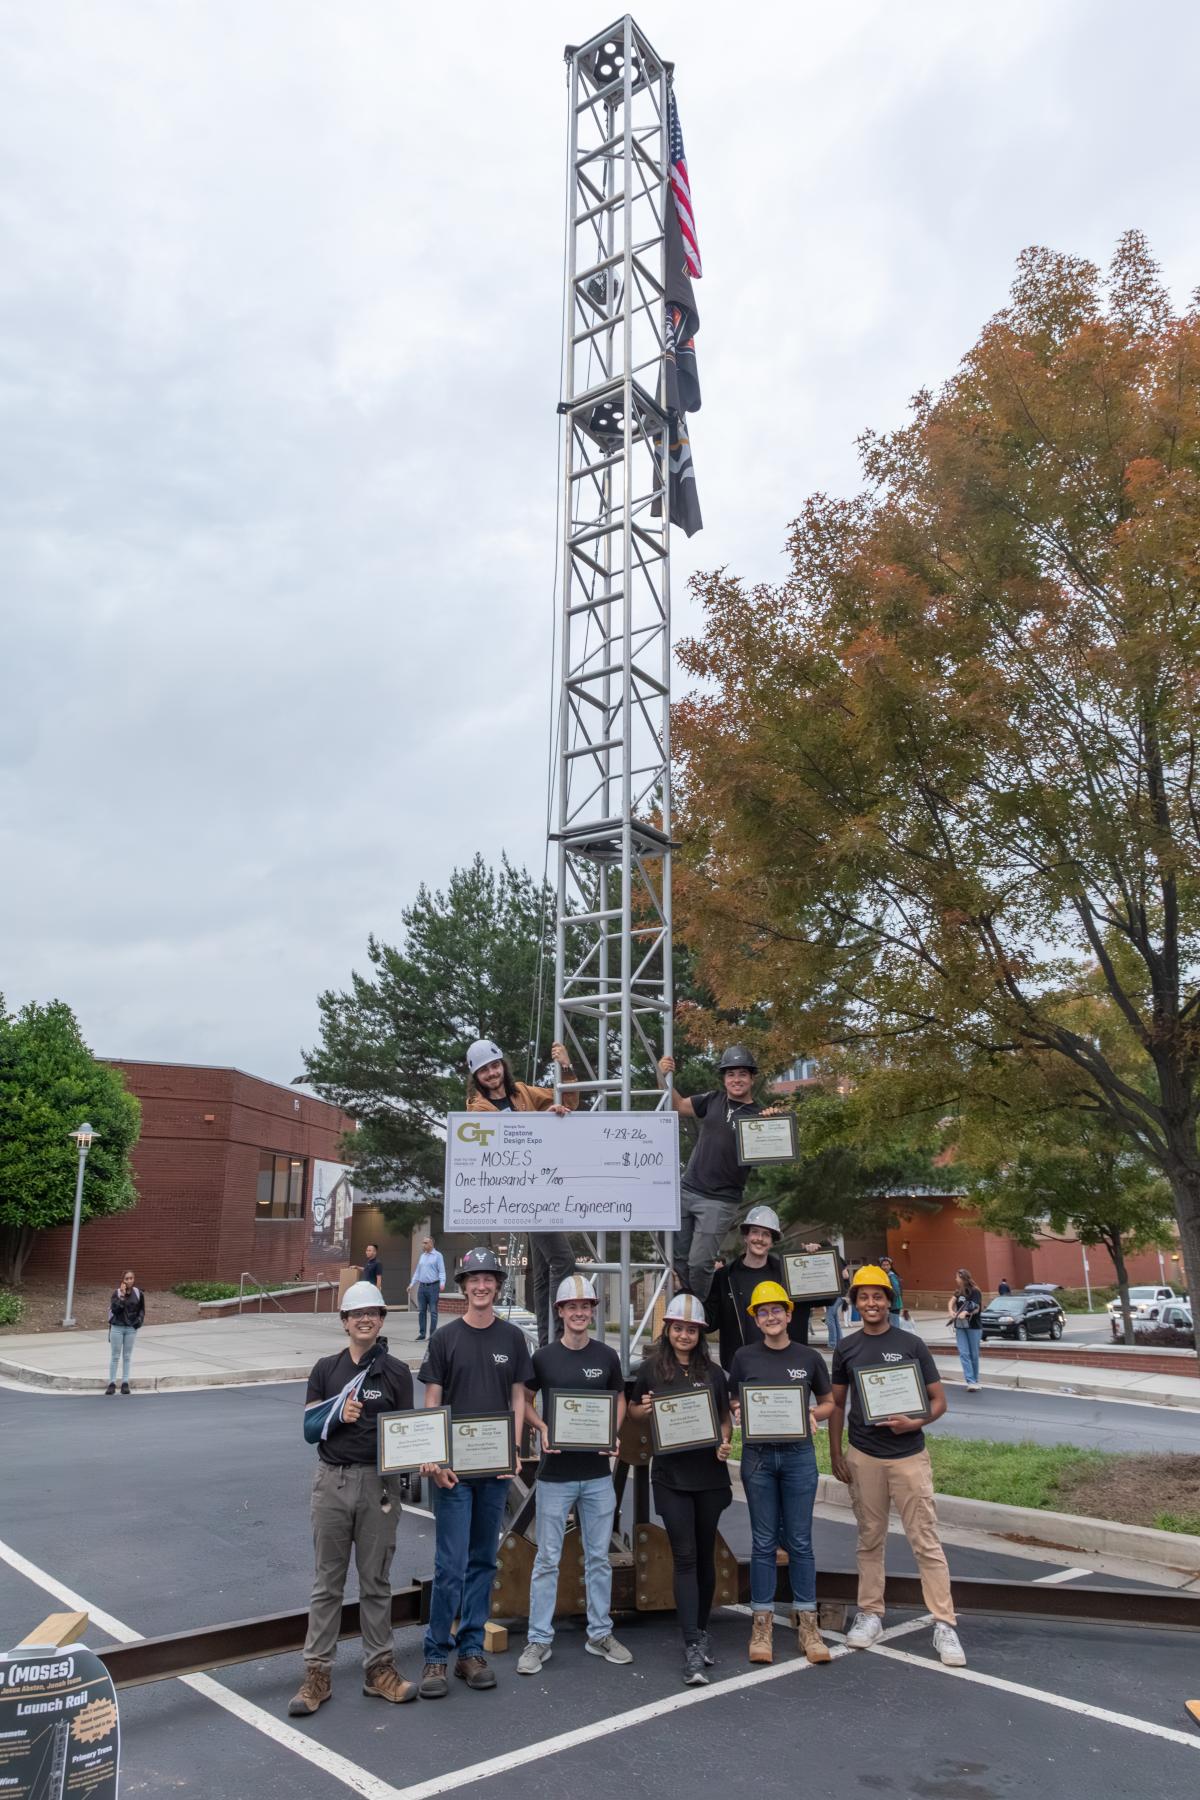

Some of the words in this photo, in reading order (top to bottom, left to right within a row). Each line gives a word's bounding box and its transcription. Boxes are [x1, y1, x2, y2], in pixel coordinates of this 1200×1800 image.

[457, 1122, 495, 1147] GT
[503, 1137, 526, 1145] Design
[527, 1137, 543, 1145] Expo
[602, 1128, 647, 1140] 4-28-26
[481, 1150, 532, 1167] MOSES
[622, 1152, 664, 1168] $1,000
[455, 1172, 476, 1187] One
[477, 1170, 527, 1187] thousand
[463, 1195, 495, 1214] Best
[497, 1195, 560, 1220] Aerospace
[564, 1195, 632, 1222] Engineering
[8, 1657, 75, 1687] (MOSES)
[16, 1698, 63, 1716] Launch
[65, 1690, 88, 1709] Rail
[72, 1751, 97, 1763] Primary
